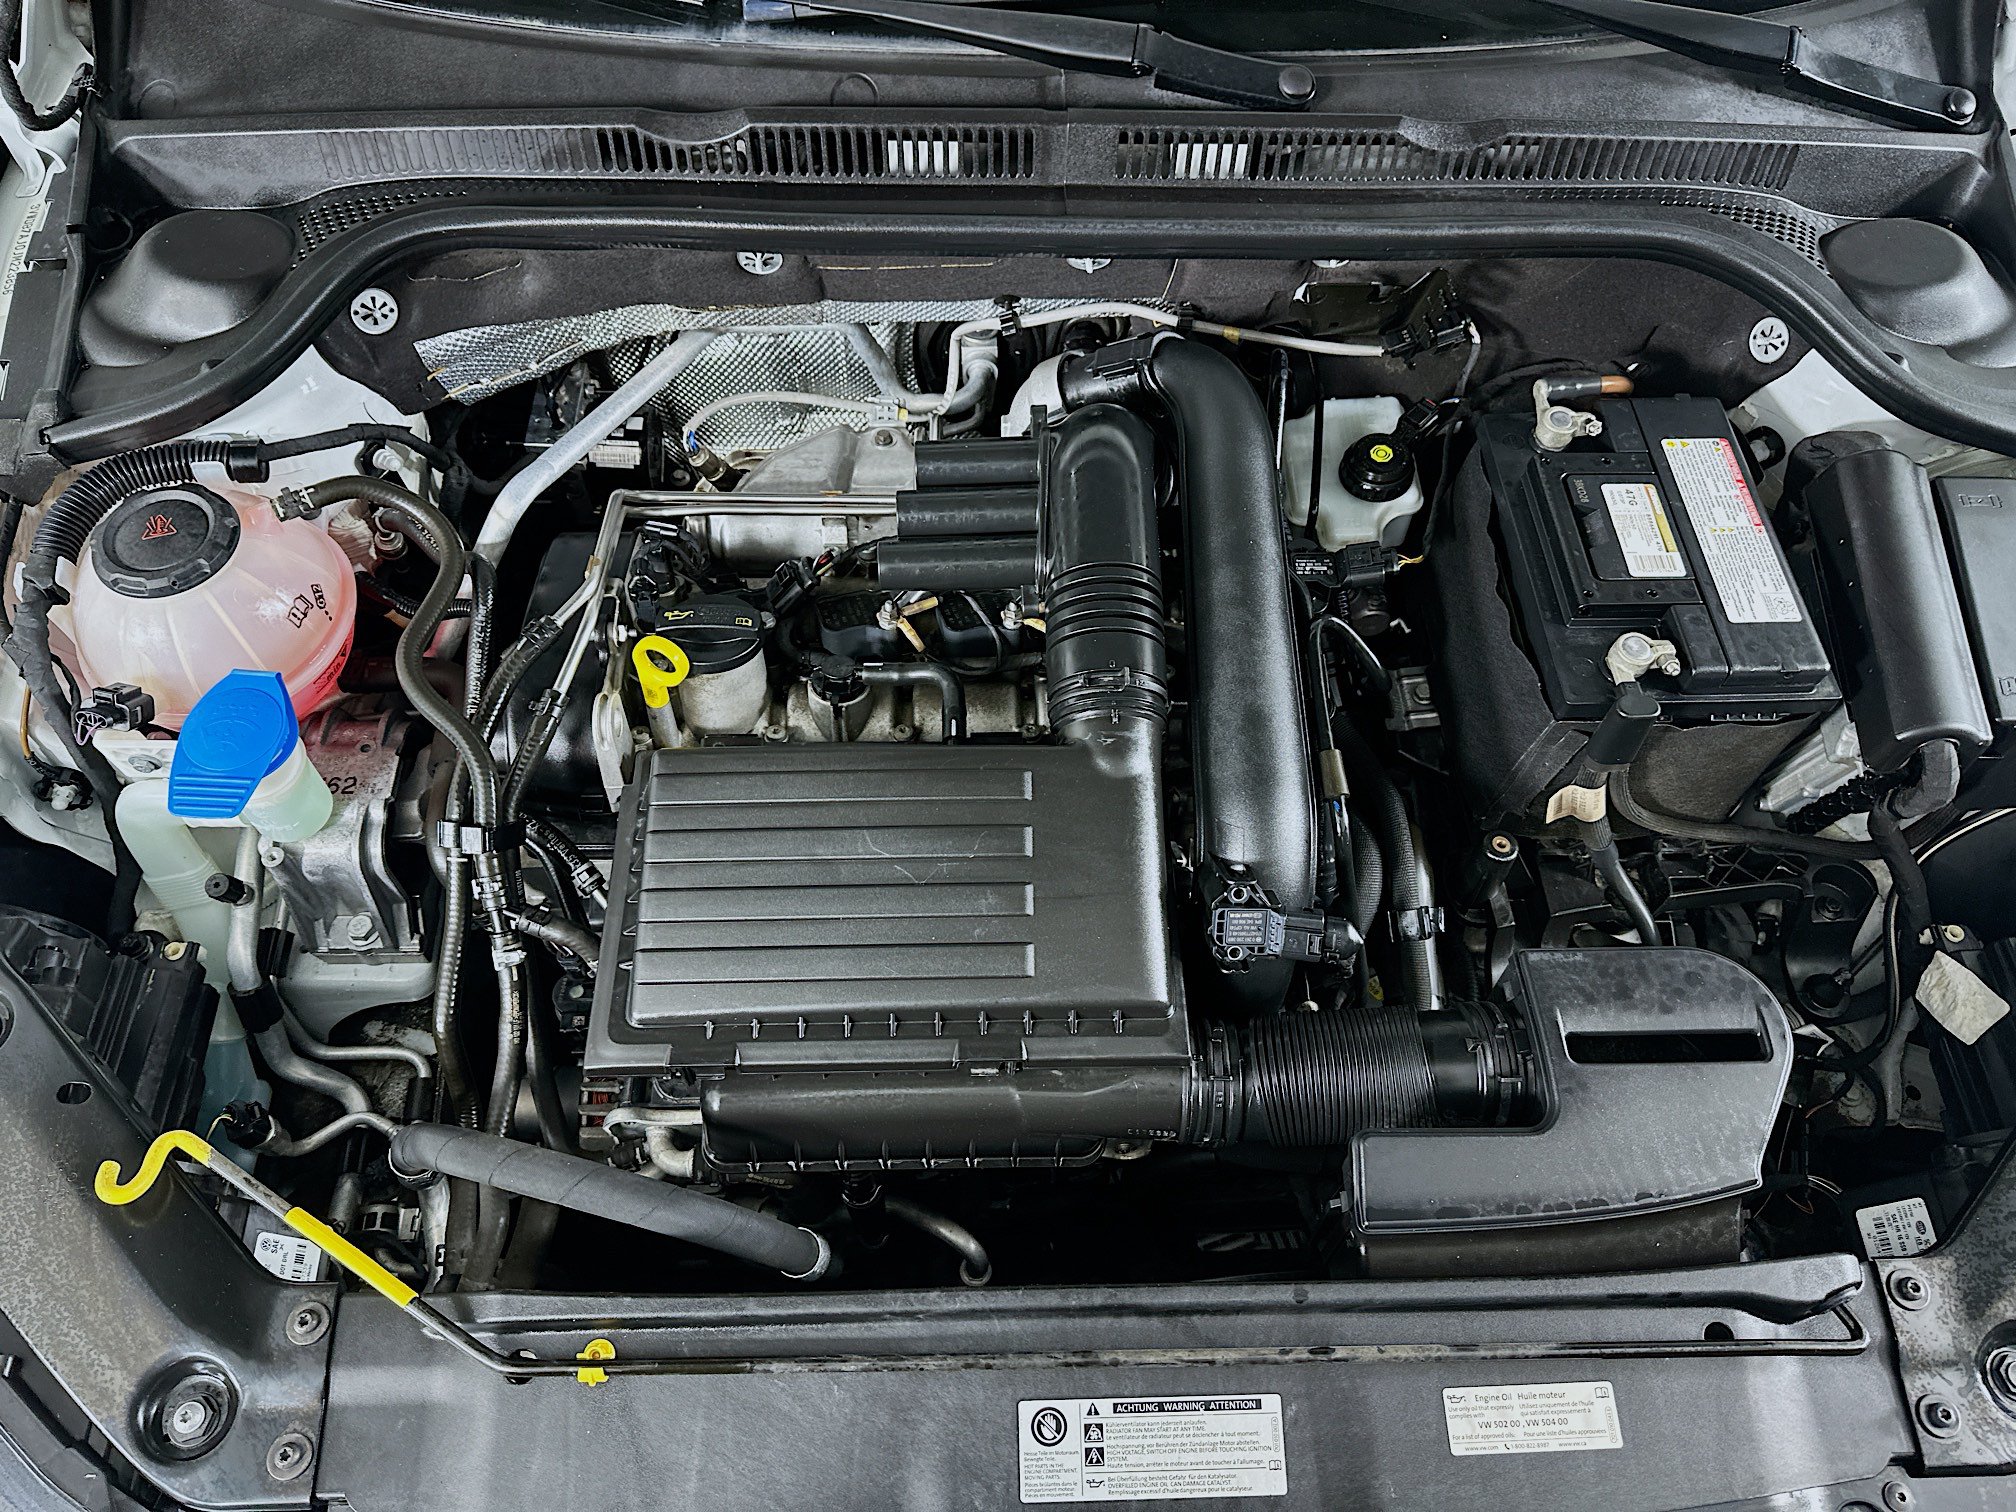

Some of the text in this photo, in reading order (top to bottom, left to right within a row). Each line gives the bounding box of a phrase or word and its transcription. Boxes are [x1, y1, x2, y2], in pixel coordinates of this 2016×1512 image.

[1625, 489, 1638, 506] 47G
[313, 584, 325, 607] G12
[326, 662, 342, 681] min
[323, 776, 357, 794] 62
[271, 1239, 279, 1253] SAE
[1117, 1401, 1256, 1412] ACHTUNG WARNING ATTENTION
[1475, 1395, 1500, 1404] Engine
